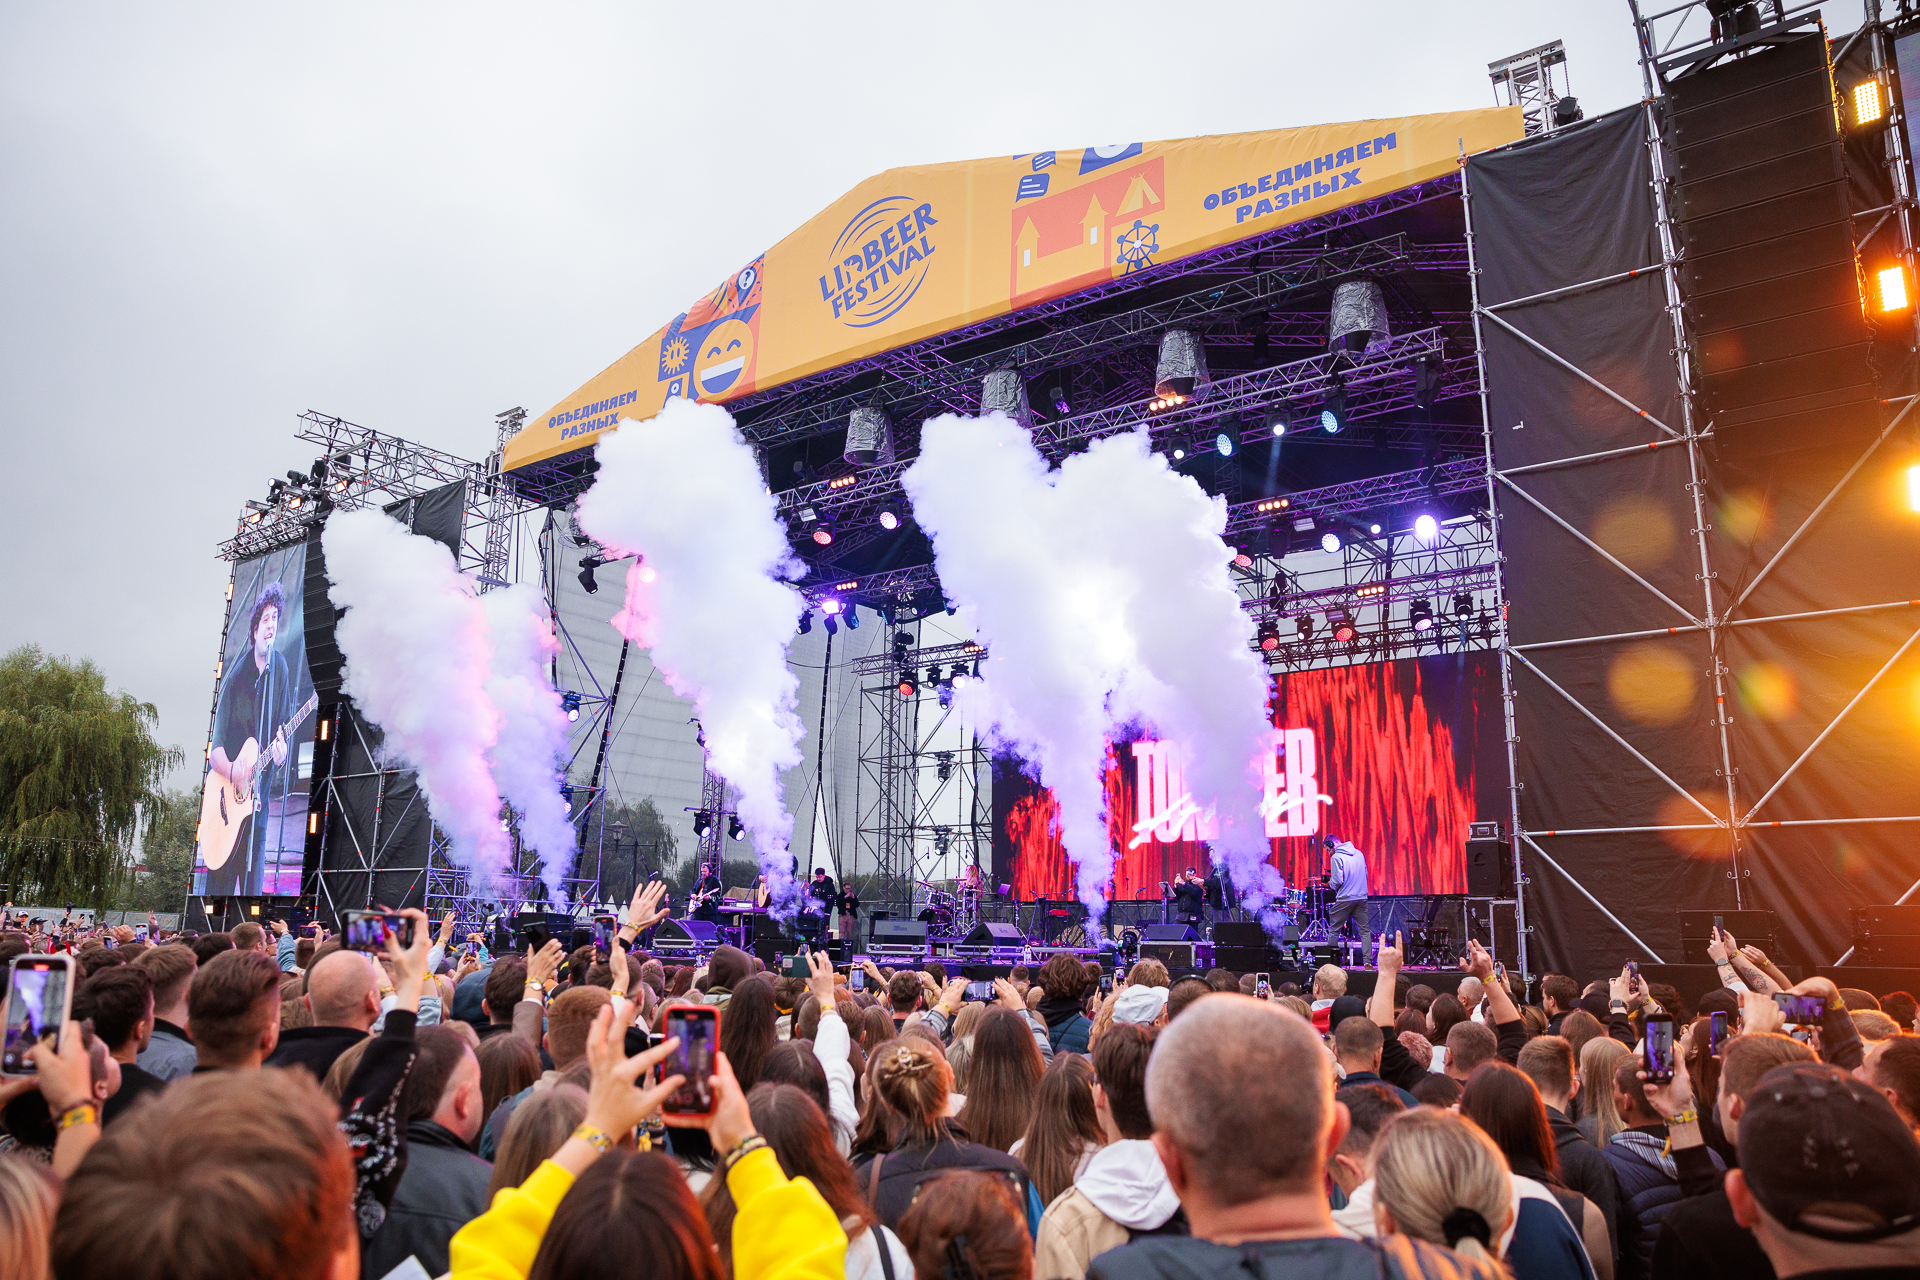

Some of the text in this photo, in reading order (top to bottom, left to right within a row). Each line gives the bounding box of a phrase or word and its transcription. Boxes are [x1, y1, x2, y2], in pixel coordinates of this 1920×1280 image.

[1203, 131, 1397, 211] ОБЪЕДИНЯЕМ
[1236, 166, 1363, 224] РАЗНЫХ
[831, 234, 936, 320] FESTIVAL
[548, 389, 638, 429] ОБЪЕДИНЯЕМ
[560, 411, 620, 441] РАЗНЫХ
